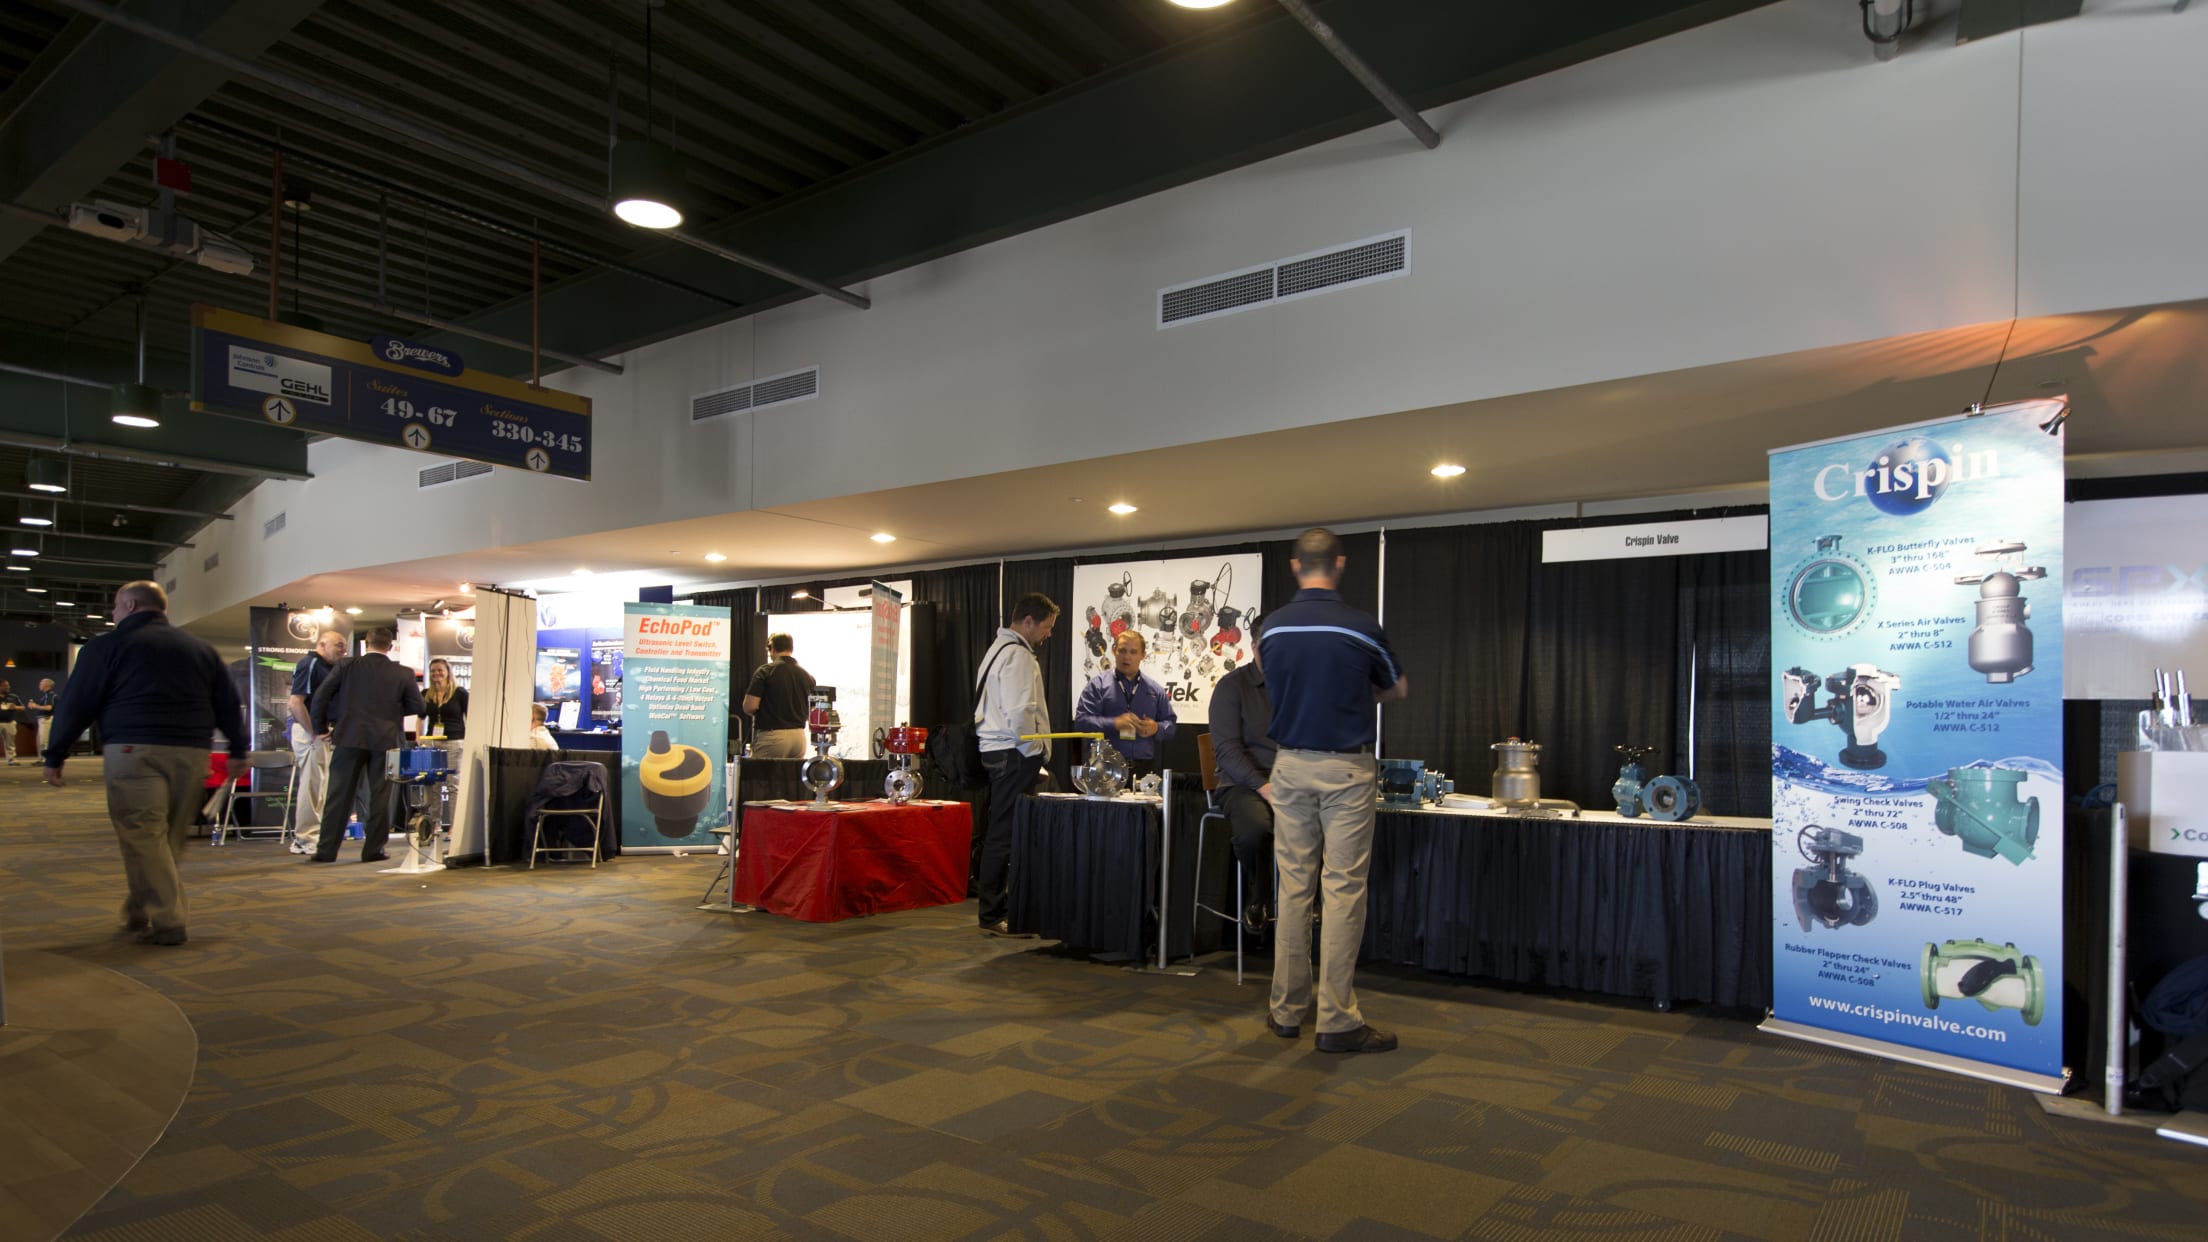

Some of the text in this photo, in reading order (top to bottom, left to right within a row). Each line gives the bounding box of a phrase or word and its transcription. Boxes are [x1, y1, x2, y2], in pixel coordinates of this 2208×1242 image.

[385, 339, 451, 368] Brewers
[281, 378, 329, 397] GEHL
[491, 420, 583, 453] 330-345
[1813, 443, 2000, 501] Crispin
[1625, 534, 1680, 547] Crispin Valve
[1867, 537, 1975, 555] K-FLO Butterfly Valves
[1903, 553, 1924, 562] thru
[1888, 565, 1920, 575] AWWA
[1877, 615, 1967, 629] X Series Air Valves
[1909, 629, 1931, 638] thru
[638, 638, 673, 647] Ultrasonic
[674, 640, 693, 648] Level
[1889, 640, 1952, 651] AWWA C-512
[635, 647, 670, 656] Controller
[685, 649, 721, 657] Transmitter
[1906, 698, 2030, 709] Potable Water Air Valves
[1956, 711, 1980, 720] thru
[1933, 723, 2000, 732] AWWA C-512
[1833, 795, 1924, 808] Swing Check Valves
[1864, 808, 1885, 817] thru
[1848, 819, 1908, 830] AWWA C-508
[1888, 878, 1975, 894] K-FLO Plug Valves
[1921, 892, 1943, 902] thru
[1899, 902, 1963, 916] AWWA C-517
[1784, 943, 1912, 970] Rubber Flapper Check Valves
[1833, 961, 1853, 972] thru
[1818, 970, 1875, 987] AWWA C-508
[1808, 994, 2007, 1043] www.crispinvalve.com
